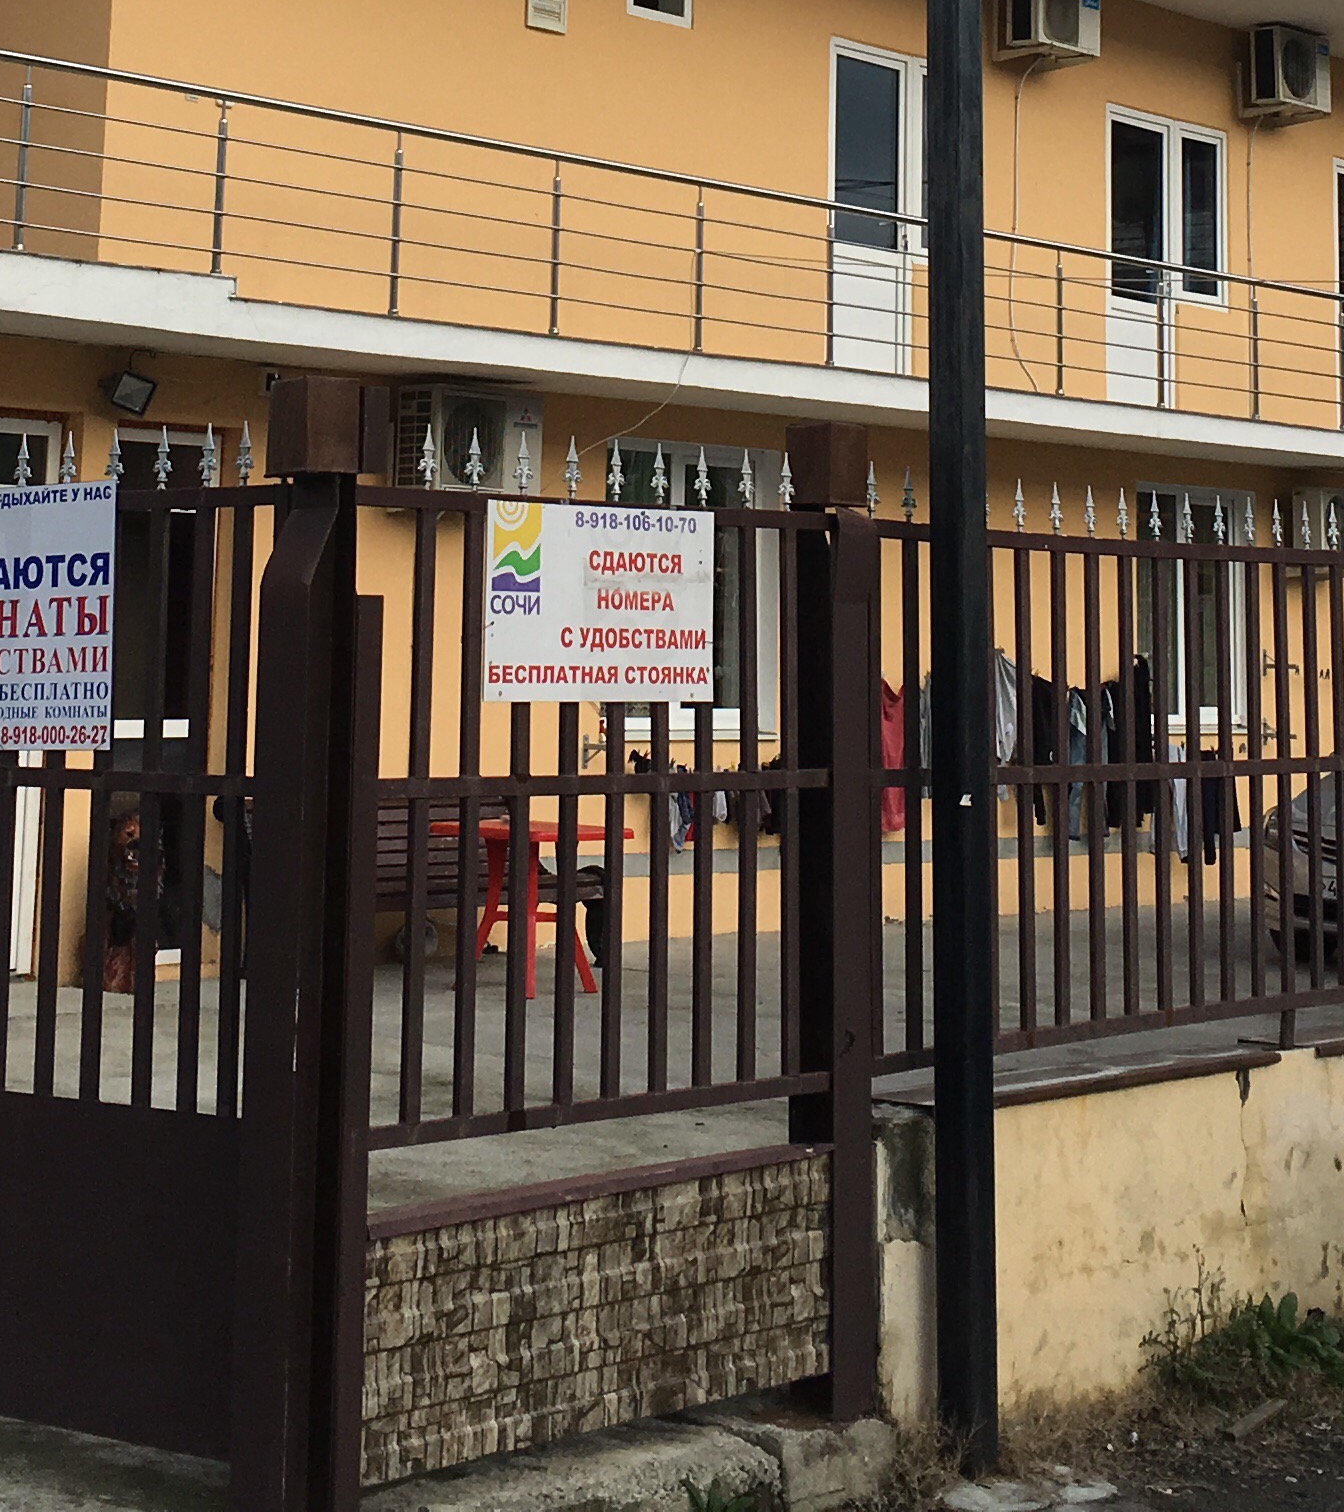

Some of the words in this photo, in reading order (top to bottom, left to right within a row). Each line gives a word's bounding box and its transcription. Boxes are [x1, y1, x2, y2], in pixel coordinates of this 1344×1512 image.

[71, 488, 82, 503] У
[84, 486, 112, 501] НАС
[575, 510, 697, 533] 8-918-106-10-70
[589, 550, 682, 575] СДАЮТСЯ
[490, 595, 541, 615] СОЧИ
[597, 589, 674, 611] НОМЕРА
[561, 627, 573, 649] С
[580, 627, 706, 652] УДОБСТВАМИ
[488, 665, 618, 684] БЕСПЛАТНАЯ
[625, 666, 708, 684] СТОЯНКА
[0, 681, 109, 701] БЕСПЛАТНО
[45, 705, 108, 718] КОМНАТЫ
[1, 725, 107, 744] 8-918-000-26-27
